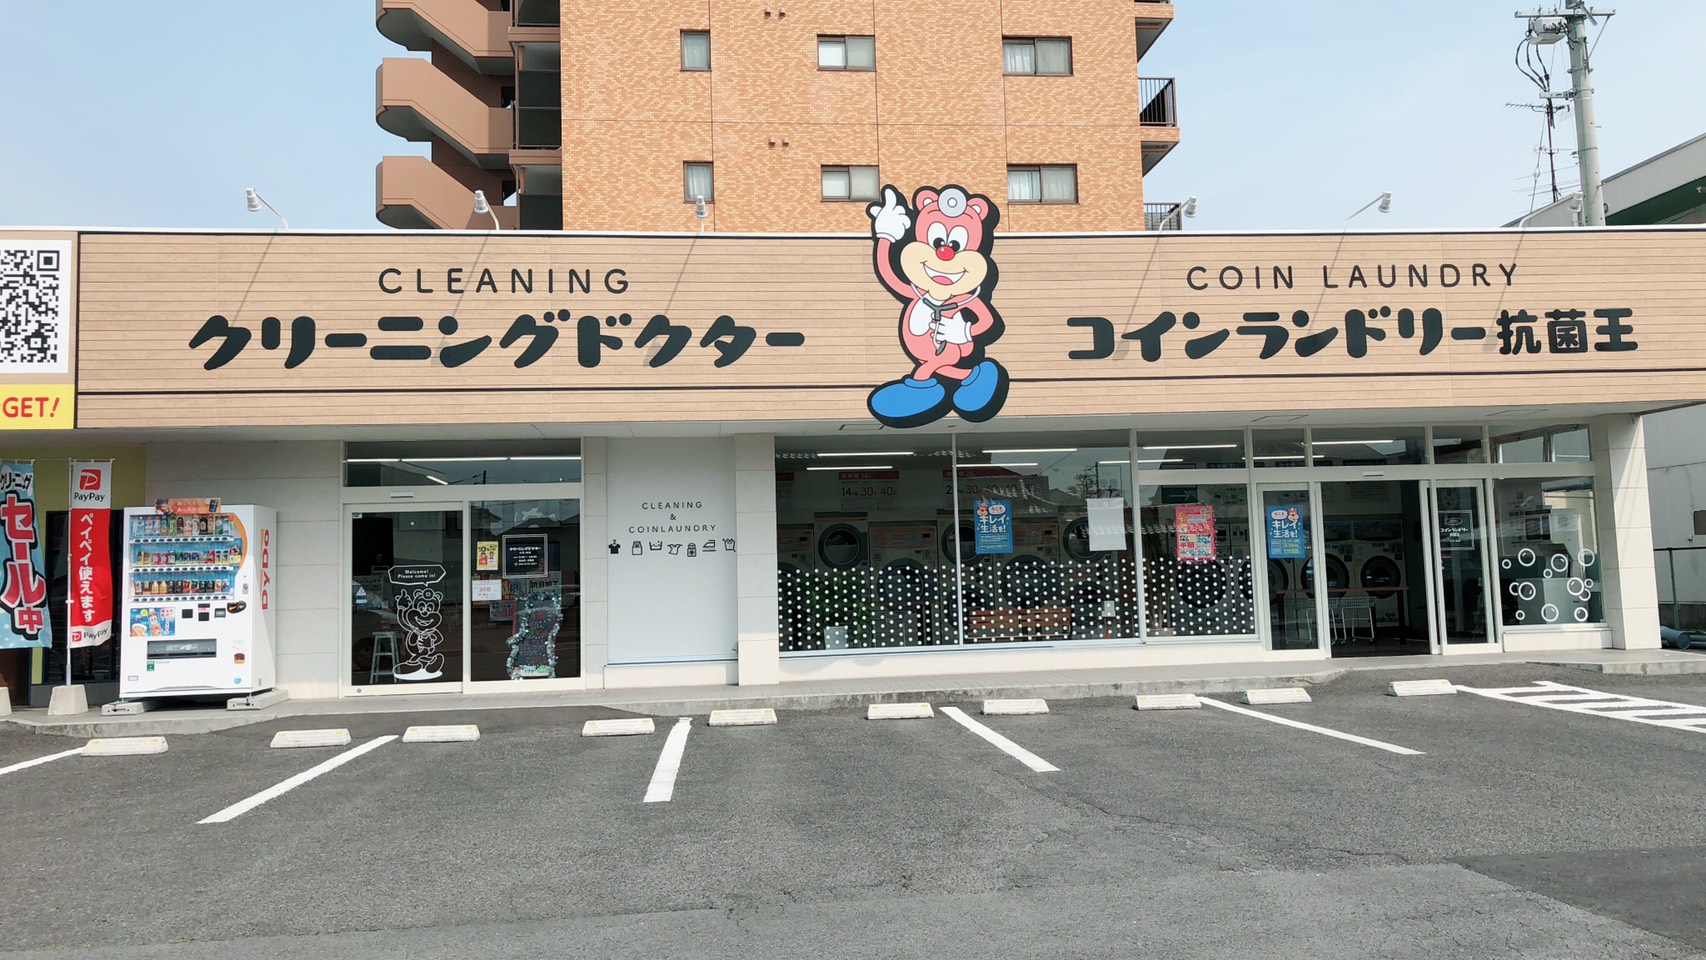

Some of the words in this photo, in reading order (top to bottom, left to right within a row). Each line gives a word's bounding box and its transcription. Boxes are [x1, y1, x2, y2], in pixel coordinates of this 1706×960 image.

[379, 268, 629, 294] CLEANING
[1187, 265, 1293, 290] COIN
[1323, 264, 1517, 289] LAUNDRY
[1067, 306, 1639, 361] コインランドリー抗菌王
[188, 309, 805, 371] クリーニングドクター
[2, 397, 60, 418] GET!
[74, 492, 105, 503] PayPay
[641, 501, 703, 510] CLEANING
[669, 513, 677, 521] &
[979, 514, 1006, 525] キレイ
[628, 524, 716, 534] COINLAUNDRY
[980, 524, 1006, 533] 生活を!
[1272, 520, 1298, 529] キレイ
[1273, 529, 1298, 538] 生活を!
[0, 496, 46, 633] セール中
[78, 513, 96, 623] ペイペイ使えます
[83, 628, 109, 639] PayPay
